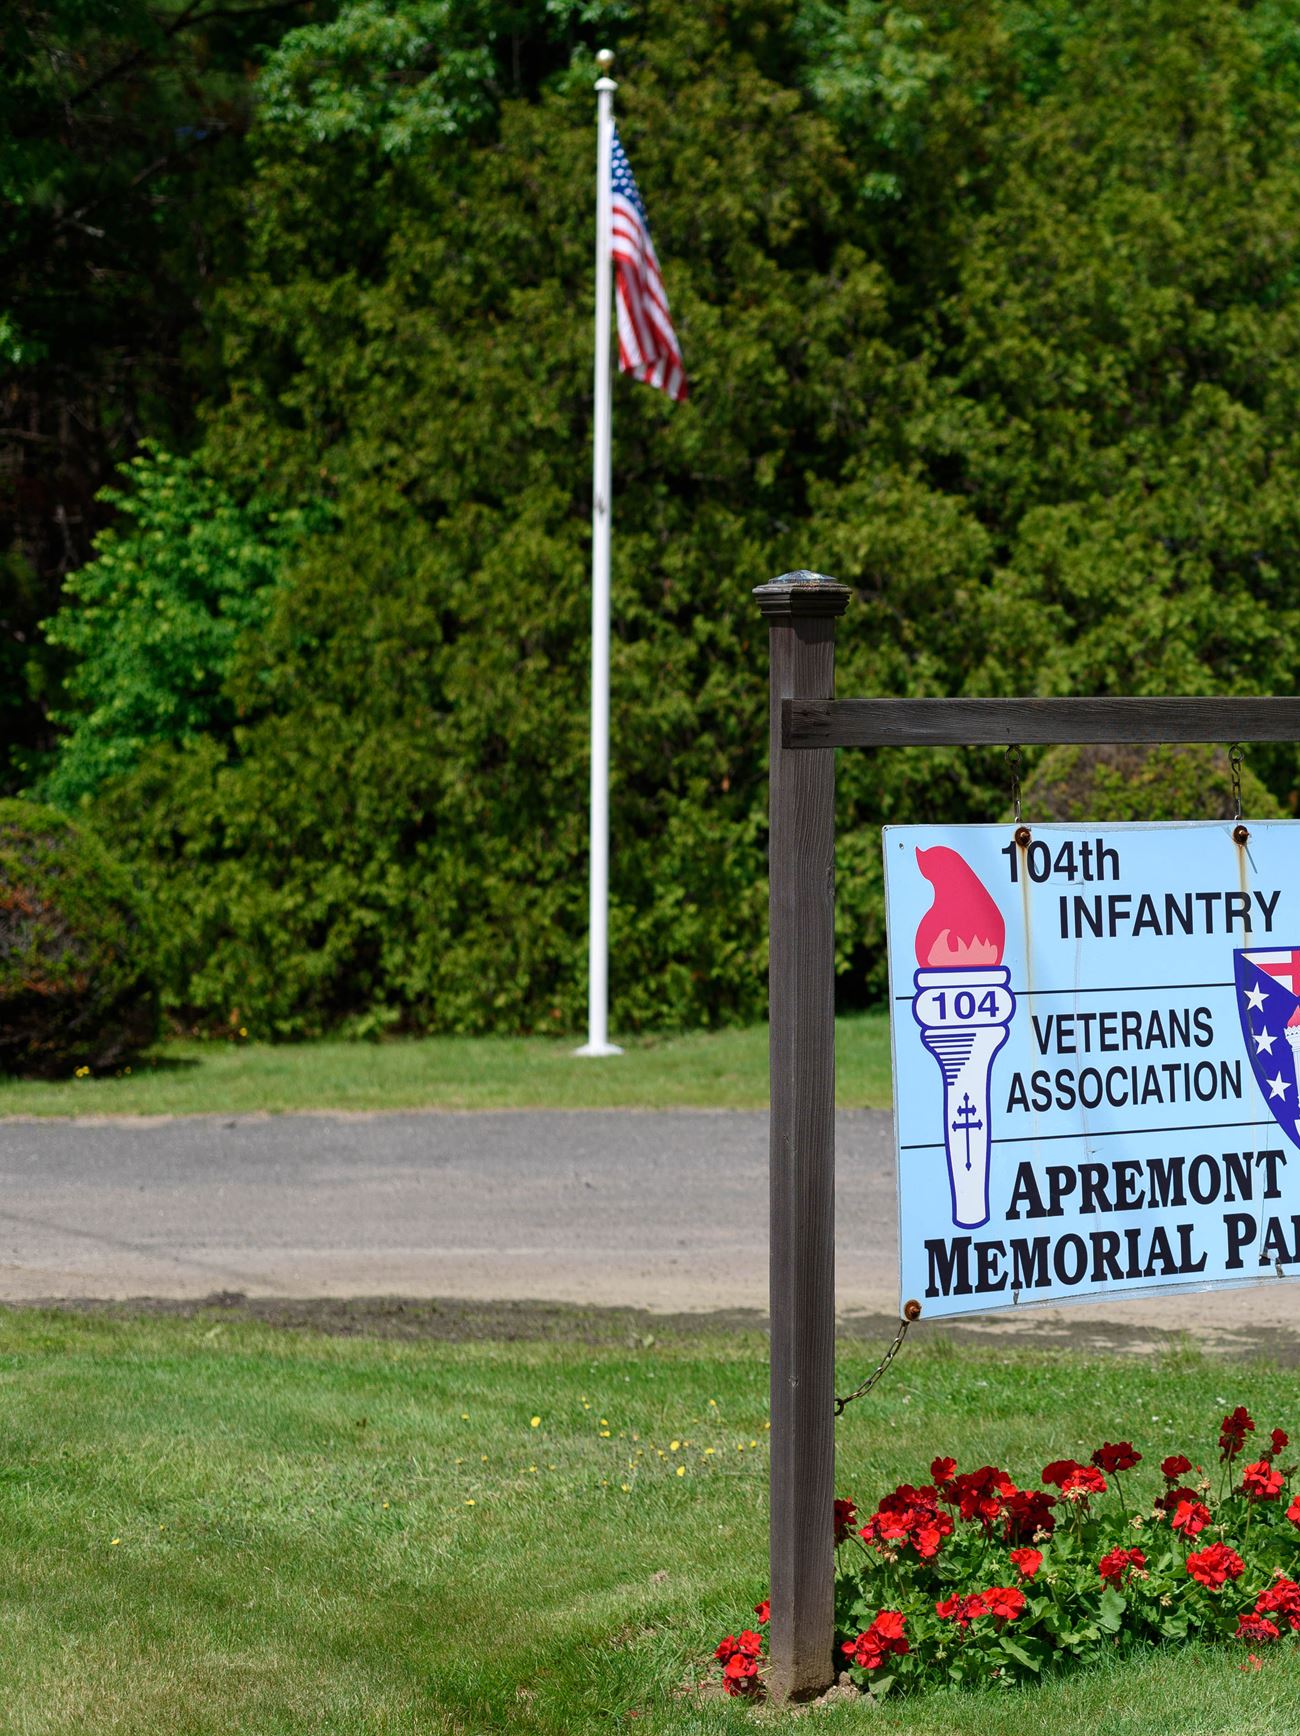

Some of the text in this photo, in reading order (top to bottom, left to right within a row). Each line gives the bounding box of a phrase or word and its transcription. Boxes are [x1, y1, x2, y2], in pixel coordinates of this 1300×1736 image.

[1001, 838, 1120, 883] 104th
[1059, 890, 1281, 939] INFANTRY
[931, 990, 1000, 1020] 104
[1031, 1006, 1214, 1055] VETERANS
[1006, 1060, 1242, 1114] ASSOCIATION
[1005, 1149, 1287, 1221] APREMONT
[924, 1223, 1208, 1299] MEMORIAL
